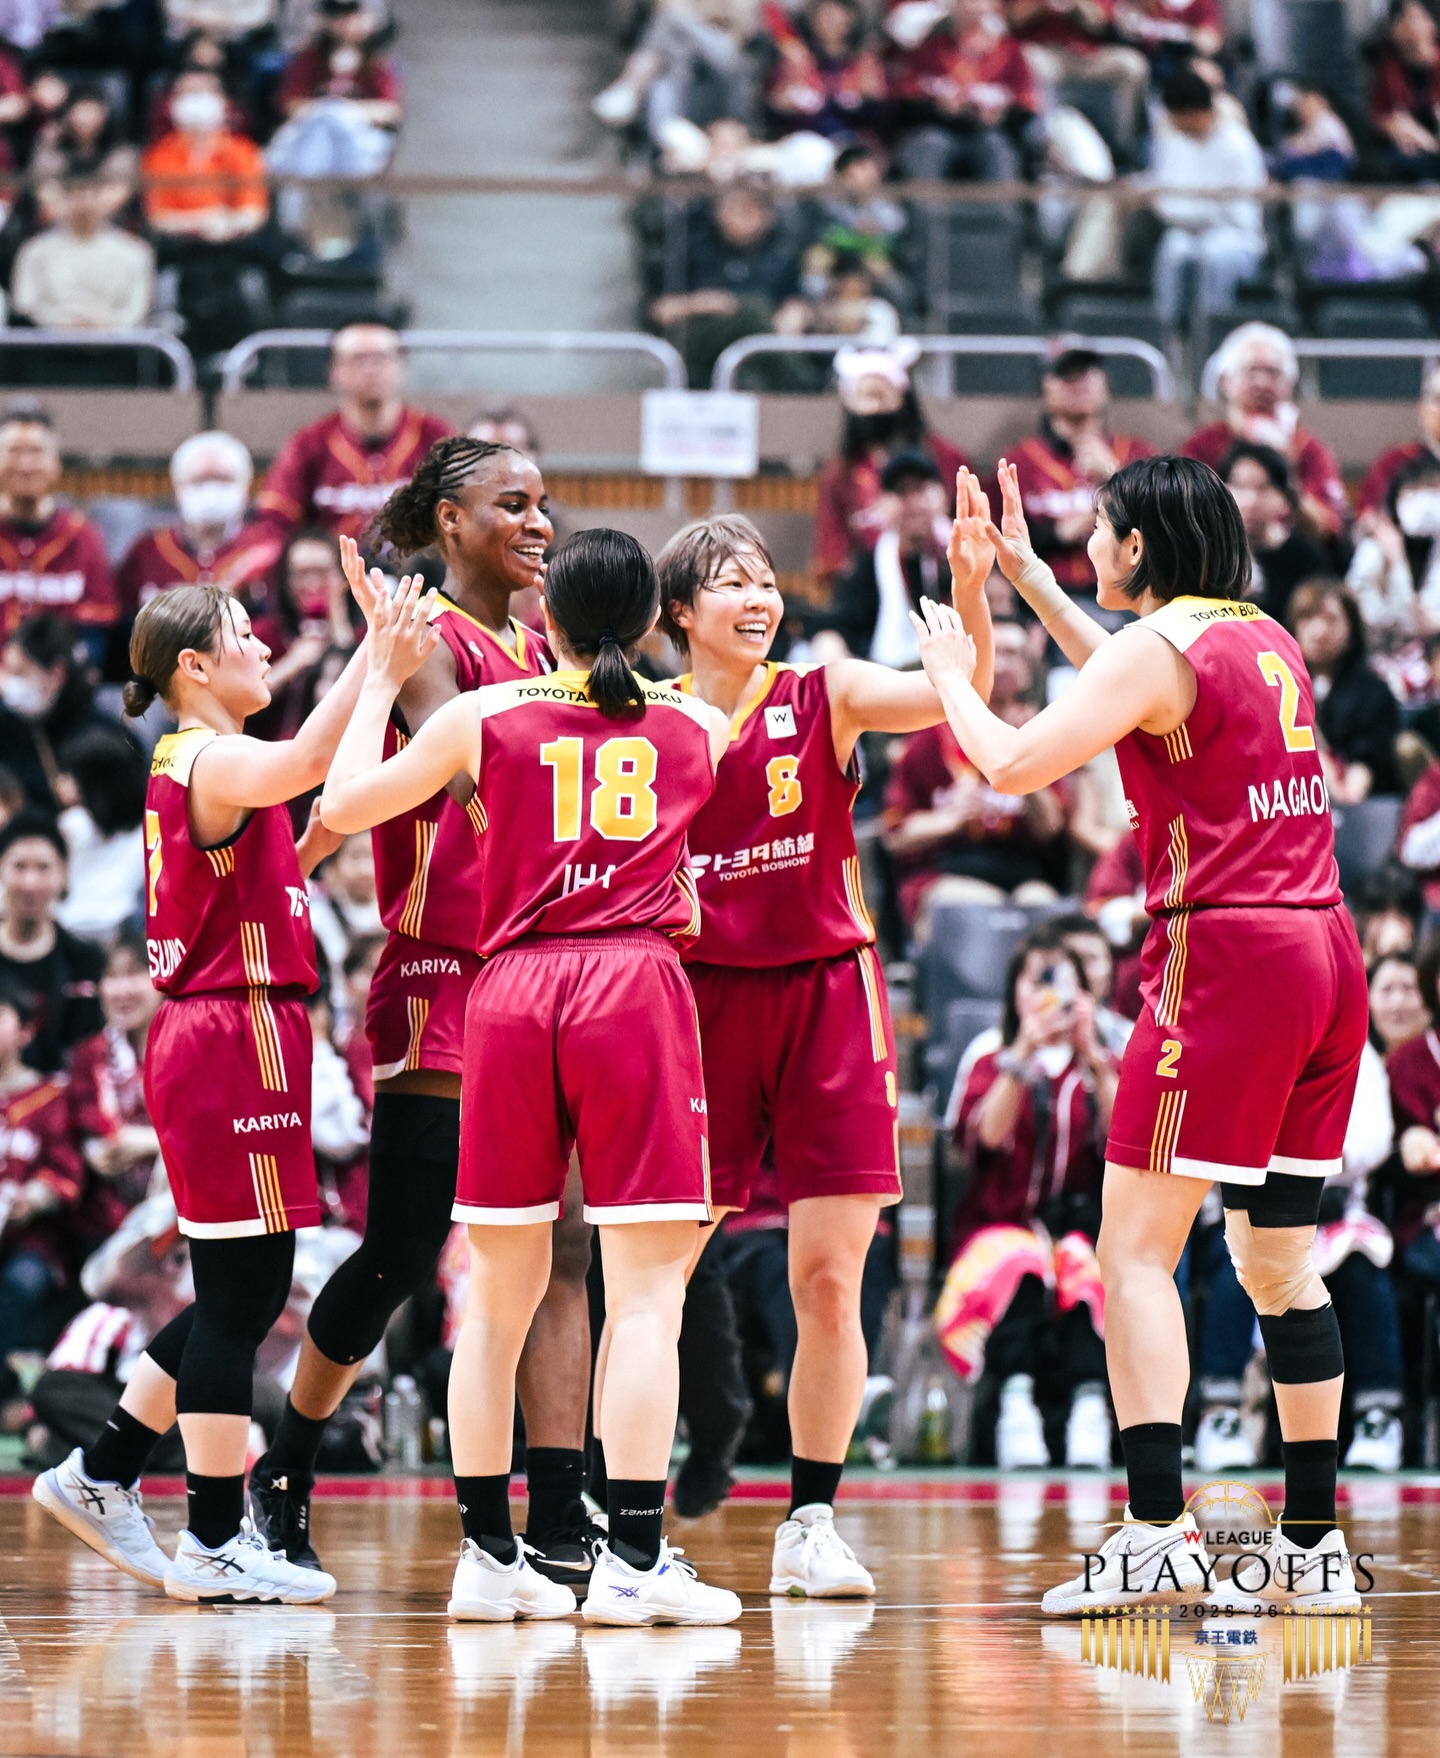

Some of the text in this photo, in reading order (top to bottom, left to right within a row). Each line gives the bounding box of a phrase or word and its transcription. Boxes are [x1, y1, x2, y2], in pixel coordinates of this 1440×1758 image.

[516, 687, 589, 703] TOYOTA
[1257, 651, 1316, 753] 2
[773, 712, 787, 724] W
[540, 736, 659, 843] 18
[765, 754, 803, 818] 8
[718, 865, 760, 882] TOYOTA
[400, 958, 462, 978] KARIYA
[1156, 1039, 1183, 1079] 2
[233, 1111, 302, 1134] KARIYA
